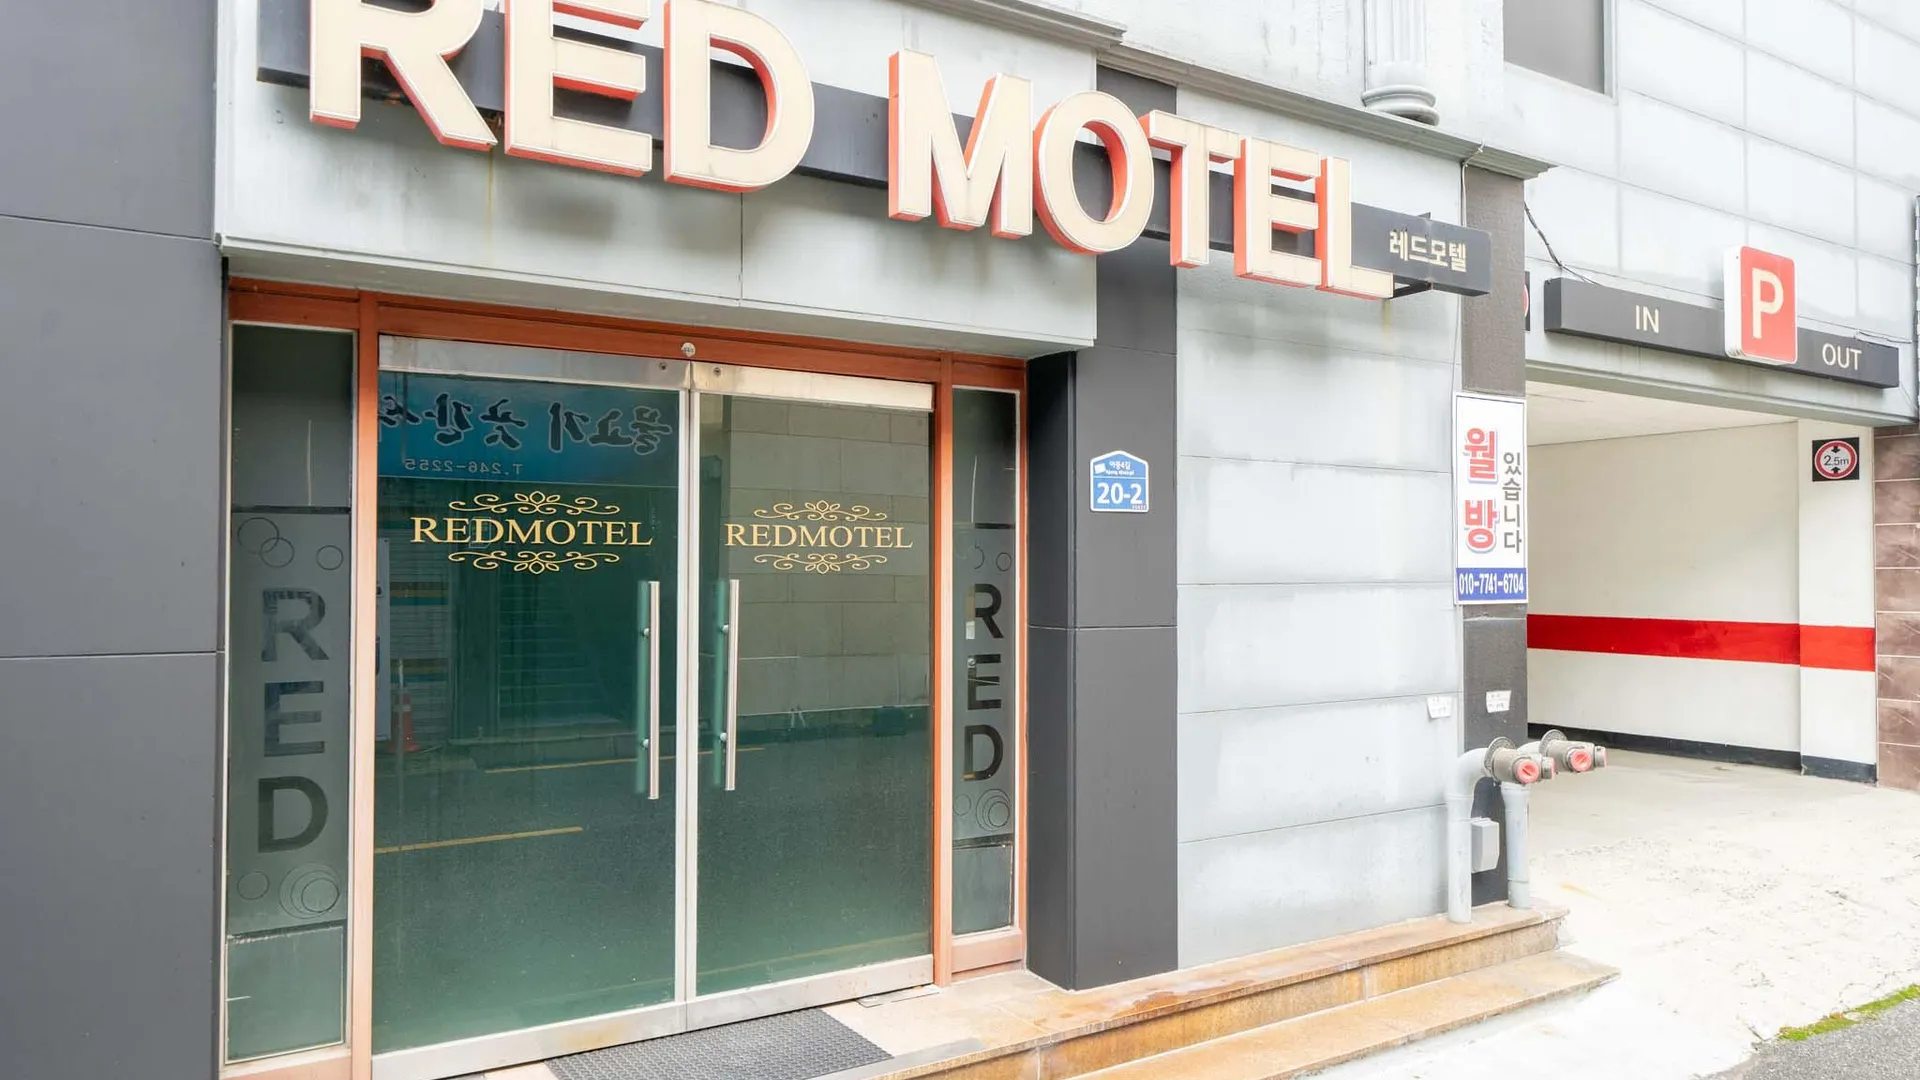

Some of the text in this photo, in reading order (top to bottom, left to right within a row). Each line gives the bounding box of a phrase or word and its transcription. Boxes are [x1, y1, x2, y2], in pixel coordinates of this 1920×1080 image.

[310, 0, 1395, 300] RED MOTEL
[1389, 229, 1468, 273] 레드모텔
[1635, 304, 1660, 334] IN
[1752, 268, 1785, 339] P
[1822, 343, 1862, 371] OUT
[1823, 454, 1850, 467] 2.5m
[1097, 482, 1143, 505] 20-2
[1464, 427, 1499, 550] 월방
[1503, 451, 1523, 554] 있습니다
[410, 516, 653, 547] REDMOTEL
[724, 523, 914, 549] REDMOTEL
[1458, 573, 1525, 596] 010-7741-6704
[963, 583, 1004, 781] RED
[257, 587, 329, 853] RED
